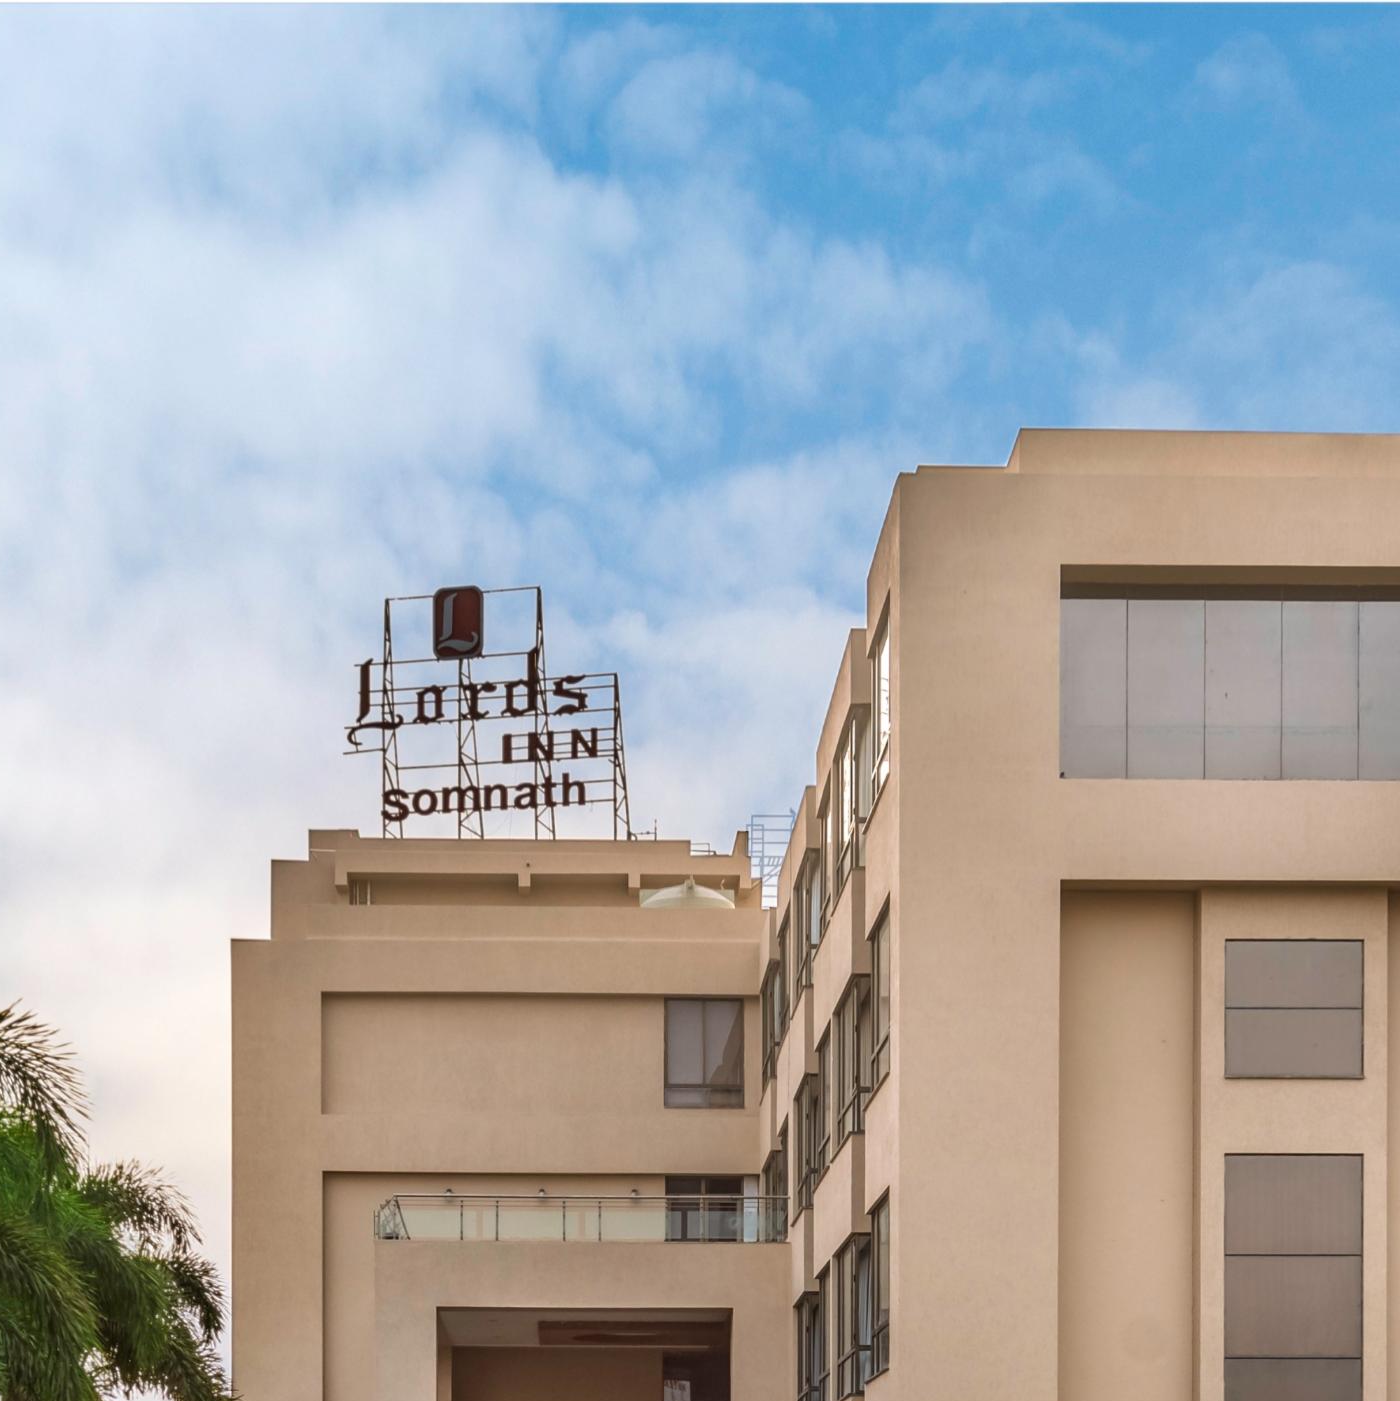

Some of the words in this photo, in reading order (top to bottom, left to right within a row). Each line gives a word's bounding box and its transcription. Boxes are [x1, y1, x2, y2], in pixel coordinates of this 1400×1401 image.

[437, 592, 479, 652] L
[347, 647, 589, 745] Lords
[502, 727, 598, 763] INN
